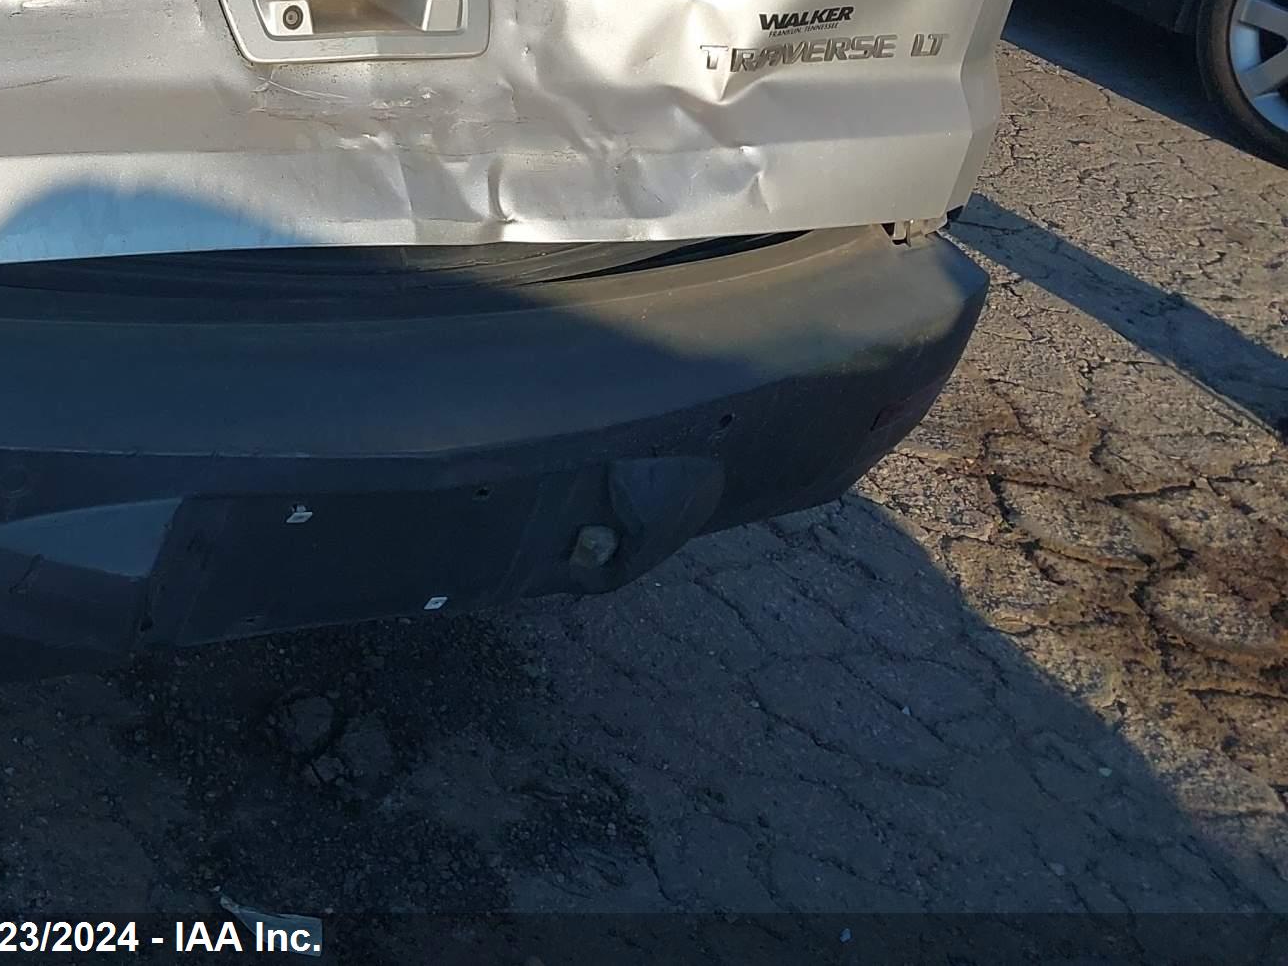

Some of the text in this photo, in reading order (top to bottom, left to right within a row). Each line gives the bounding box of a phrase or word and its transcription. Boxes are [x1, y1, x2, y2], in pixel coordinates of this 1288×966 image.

[759, 6, 854, 30] WALKER
[700, 33, 949, 72] TRAVERSE LT
